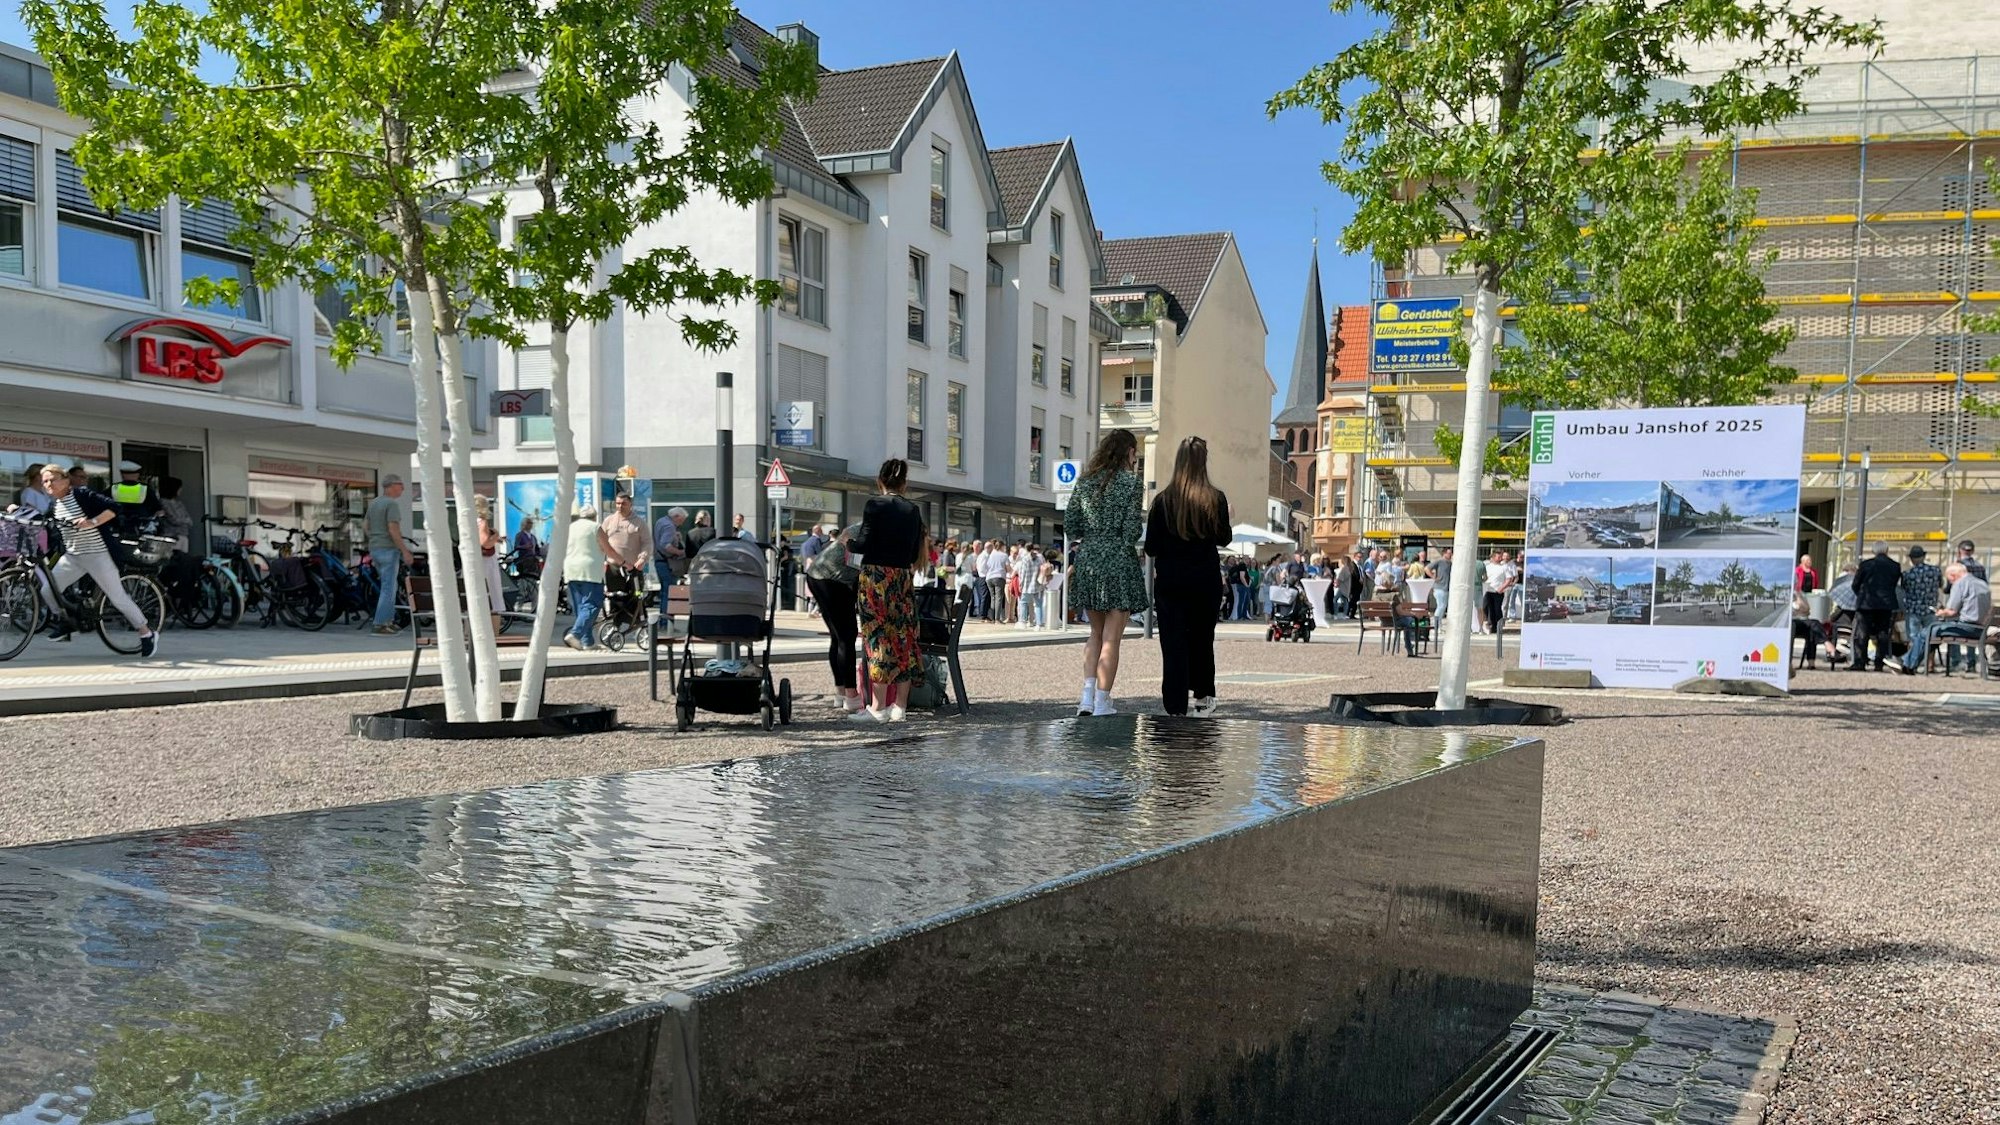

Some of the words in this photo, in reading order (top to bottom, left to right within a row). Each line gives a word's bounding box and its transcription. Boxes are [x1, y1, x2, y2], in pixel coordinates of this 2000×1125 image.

[1400, 309, 1454, 320] Gerüstbau
[1377, 325, 1417, 336] Wilhelm
[1393, 339, 1440, 347] Meisterbetrieb
[138, 336, 224, 384] LBS
[1409, 354, 1420, 362] 27
[500, 401, 522, 414] LBS
[1566, 423, 1629, 436] Umbau
[1635, 420, 1710, 435] Janshof
[1715, 419, 1763, 433] 2025
[0, 434, 39, 448] zieren
[42, 437, 105, 453] Bausparen
[1535, 418, 1554, 463] Brühl
[1568, 470, 1601, 480] Vorher
[1702, 468, 1746, 478] Nachher
